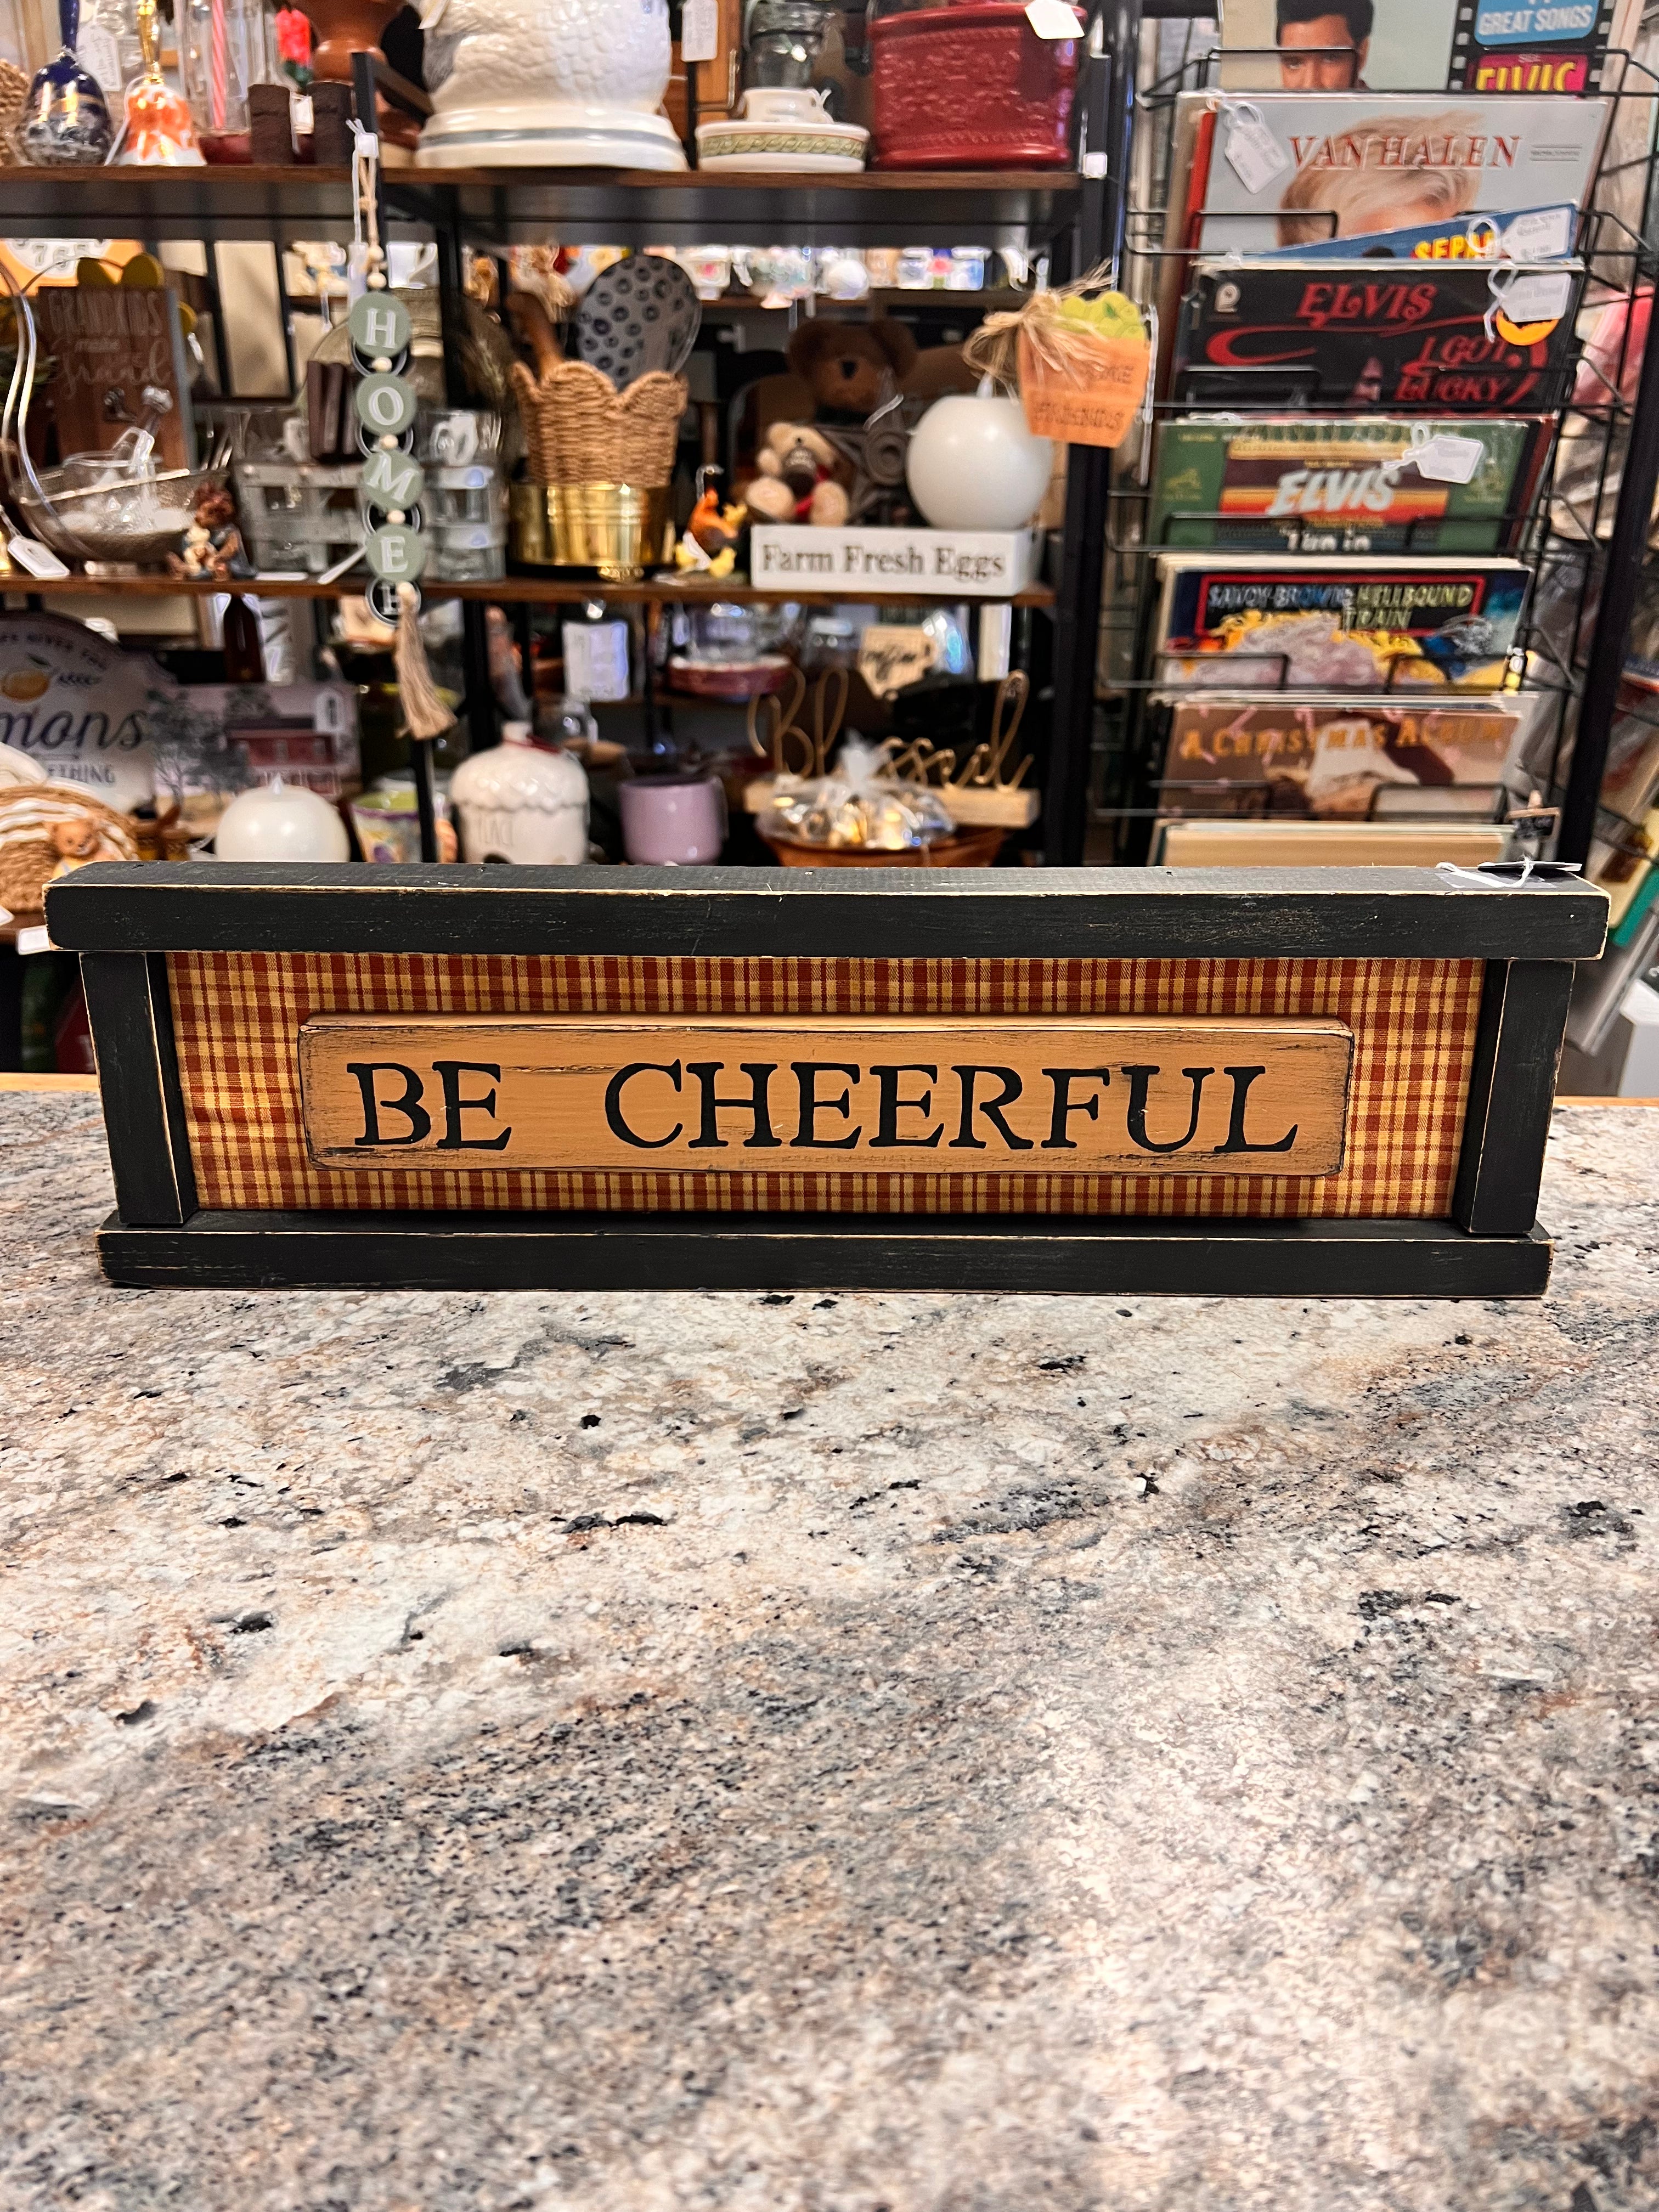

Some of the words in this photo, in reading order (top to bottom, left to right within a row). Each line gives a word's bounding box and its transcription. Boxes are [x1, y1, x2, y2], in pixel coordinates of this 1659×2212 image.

[1535, 5, 1593, 31] SONGS
[1289, 135, 1375, 170] VAN
[1376, 135, 1523, 170] HALEN
[1295, 282, 1438, 329] ELVIS
[1266, 468, 1402, 517] ELVIS
[762, 544, 834, 572] Farm
[843, 545, 926, 574] Fresh
[934, 546, 1006, 583] Eggs
[346, 1060, 511, 1150] BE
[605, 1059, 1297, 1153] CHEERFUL
